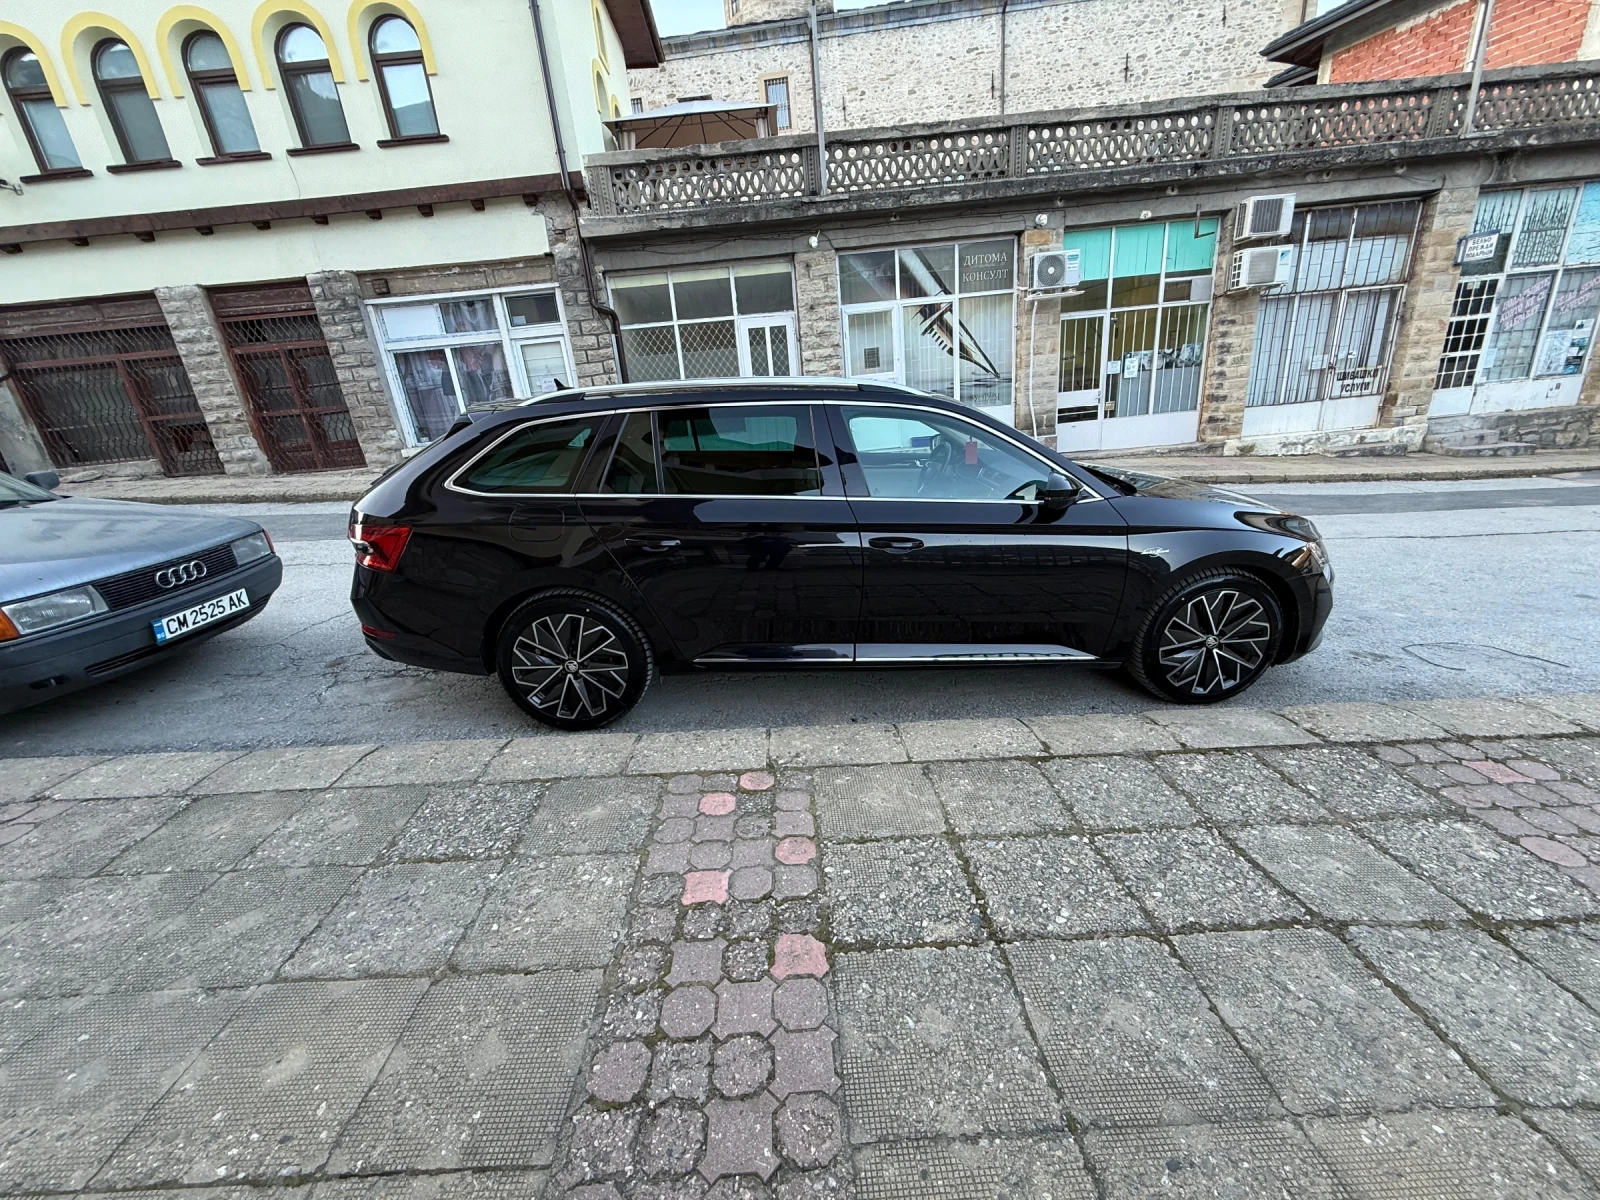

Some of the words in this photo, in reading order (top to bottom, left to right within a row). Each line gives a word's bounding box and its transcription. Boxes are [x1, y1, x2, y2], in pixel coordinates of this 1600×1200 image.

[1467, 242, 1494, 252] ПРЕЖДИ
[1472, 236, 1492, 246] БЕЛЬО
[963, 252, 1008, 267] ДИТОМА
[962, 268, 1009, 284] КОНСУЛТ
[1336, 368, 1379, 381] ШИВАШКИ
[1341, 381, 1371, 393] УСЛУГИ
[189, 599, 226, 626] 2525
